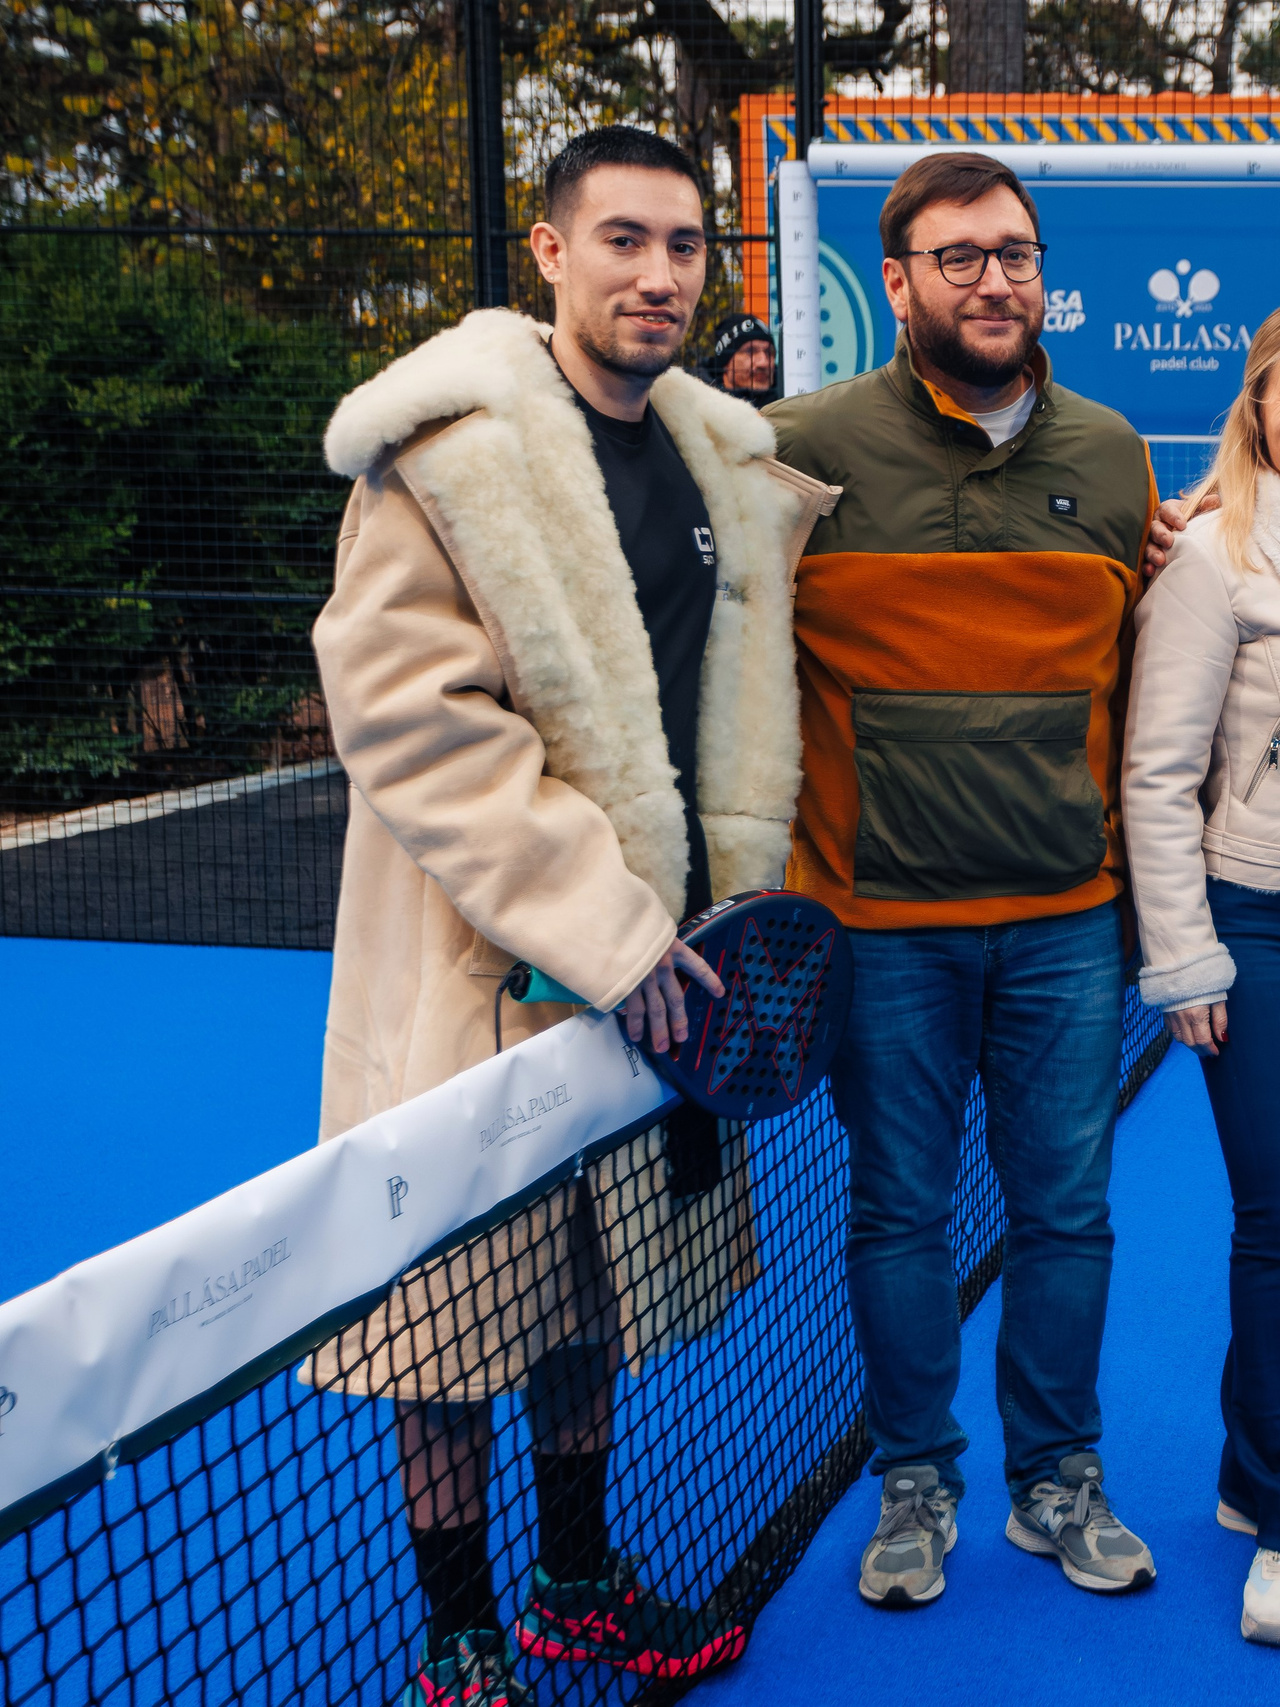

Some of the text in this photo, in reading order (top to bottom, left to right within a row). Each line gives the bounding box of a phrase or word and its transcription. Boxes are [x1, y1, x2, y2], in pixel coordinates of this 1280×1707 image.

[1044, 289, 1083, 311] SA
[1043, 311, 1086, 333] CUP
[1114, 322, 1252, 351] PALLASA
[1150, 355, 1220, 373] padel club
